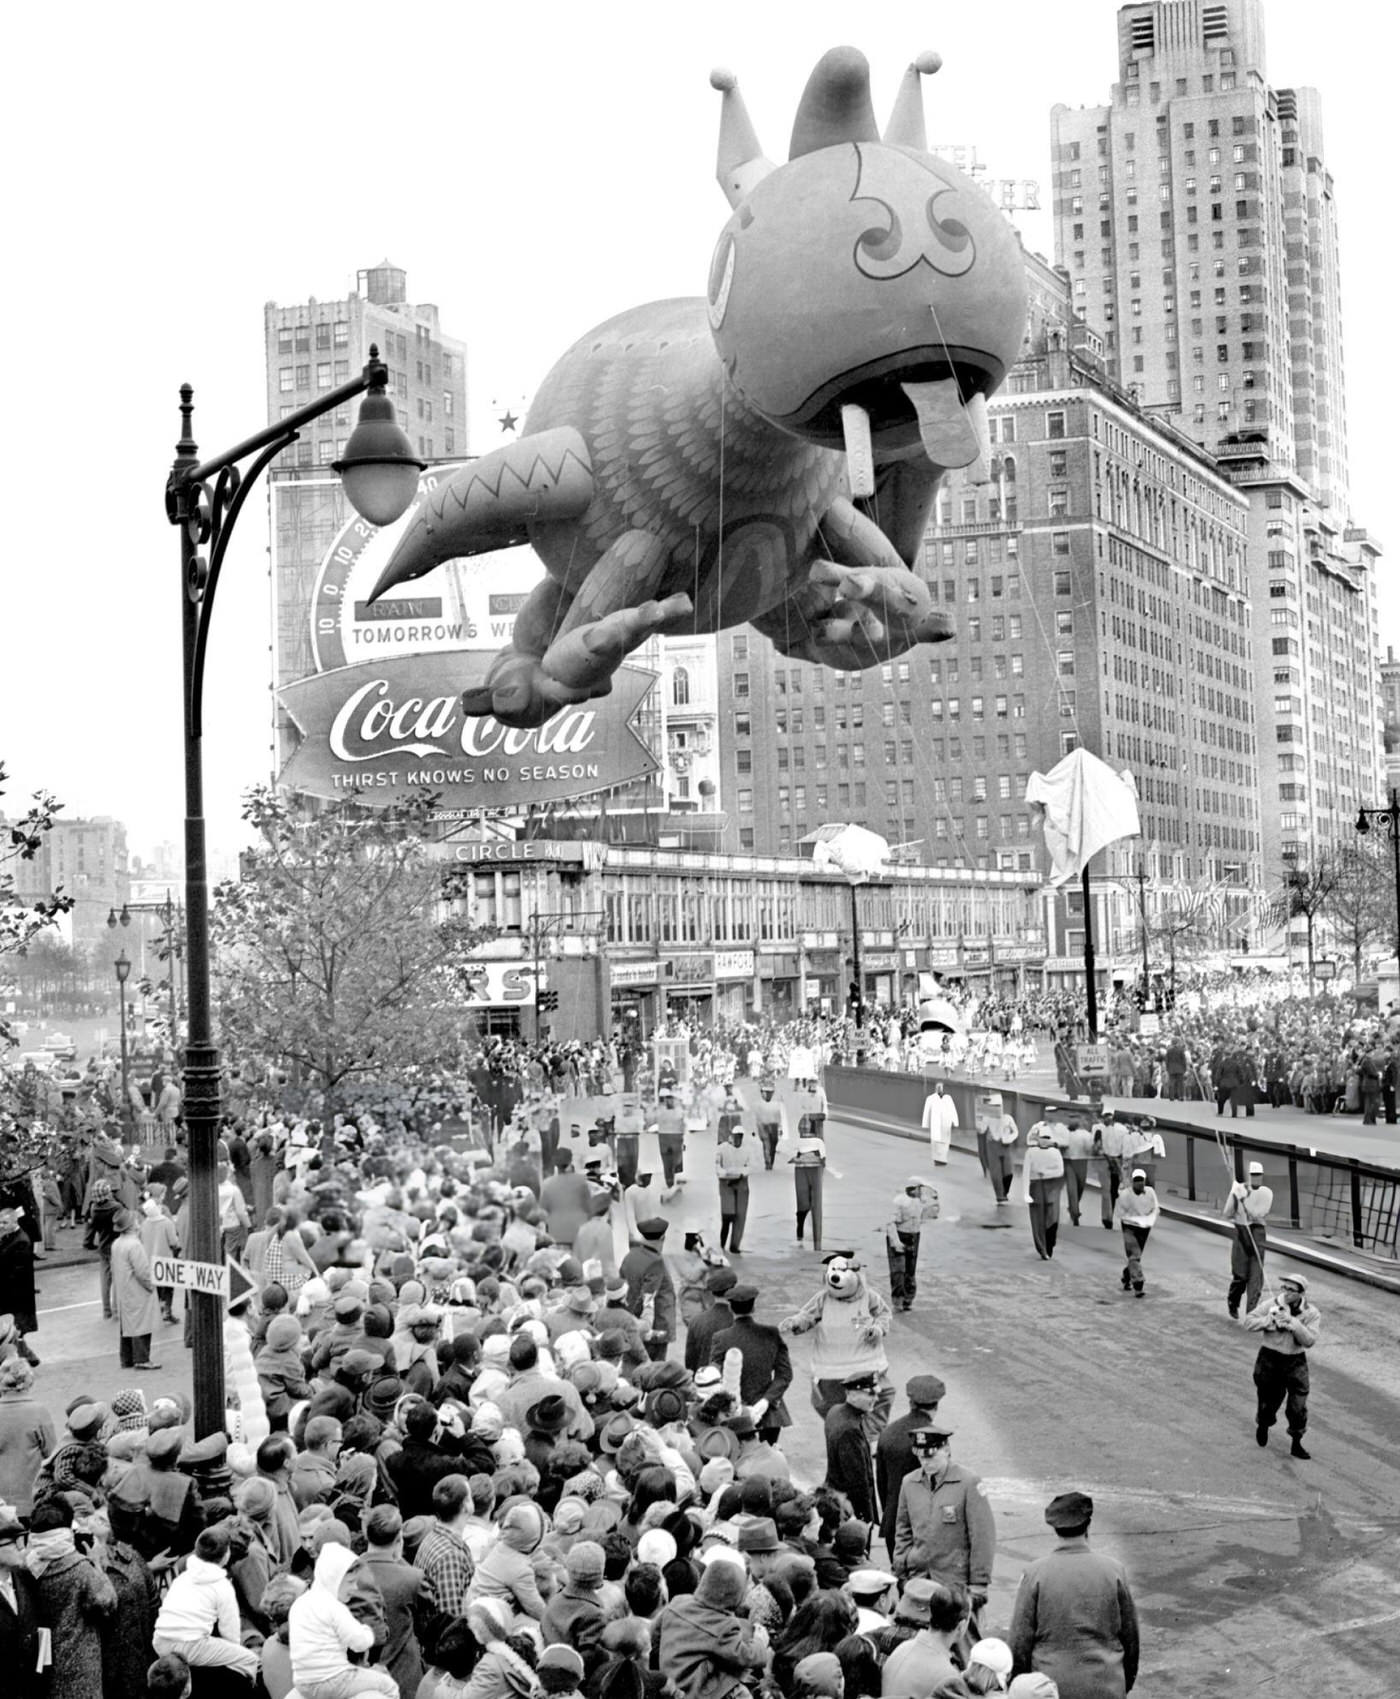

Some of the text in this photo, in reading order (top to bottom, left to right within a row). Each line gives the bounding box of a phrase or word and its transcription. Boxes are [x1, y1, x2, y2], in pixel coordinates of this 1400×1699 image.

[334, 546, 353, 565] 10
[323, 584, 339, 595] 0
[372, 601, 424, 616] RAIN
[319, 618, 335, 634] 10
[352, 622, 478, 644] TOMORROWS
[329, 680, 457, 762] Coca
[331, 764, 599, 788] THIRST KNOWS NO SEASON
[455, 843, 535, 860] CIRCLE
[154, 1260, 224, 1290] ONE WAY
